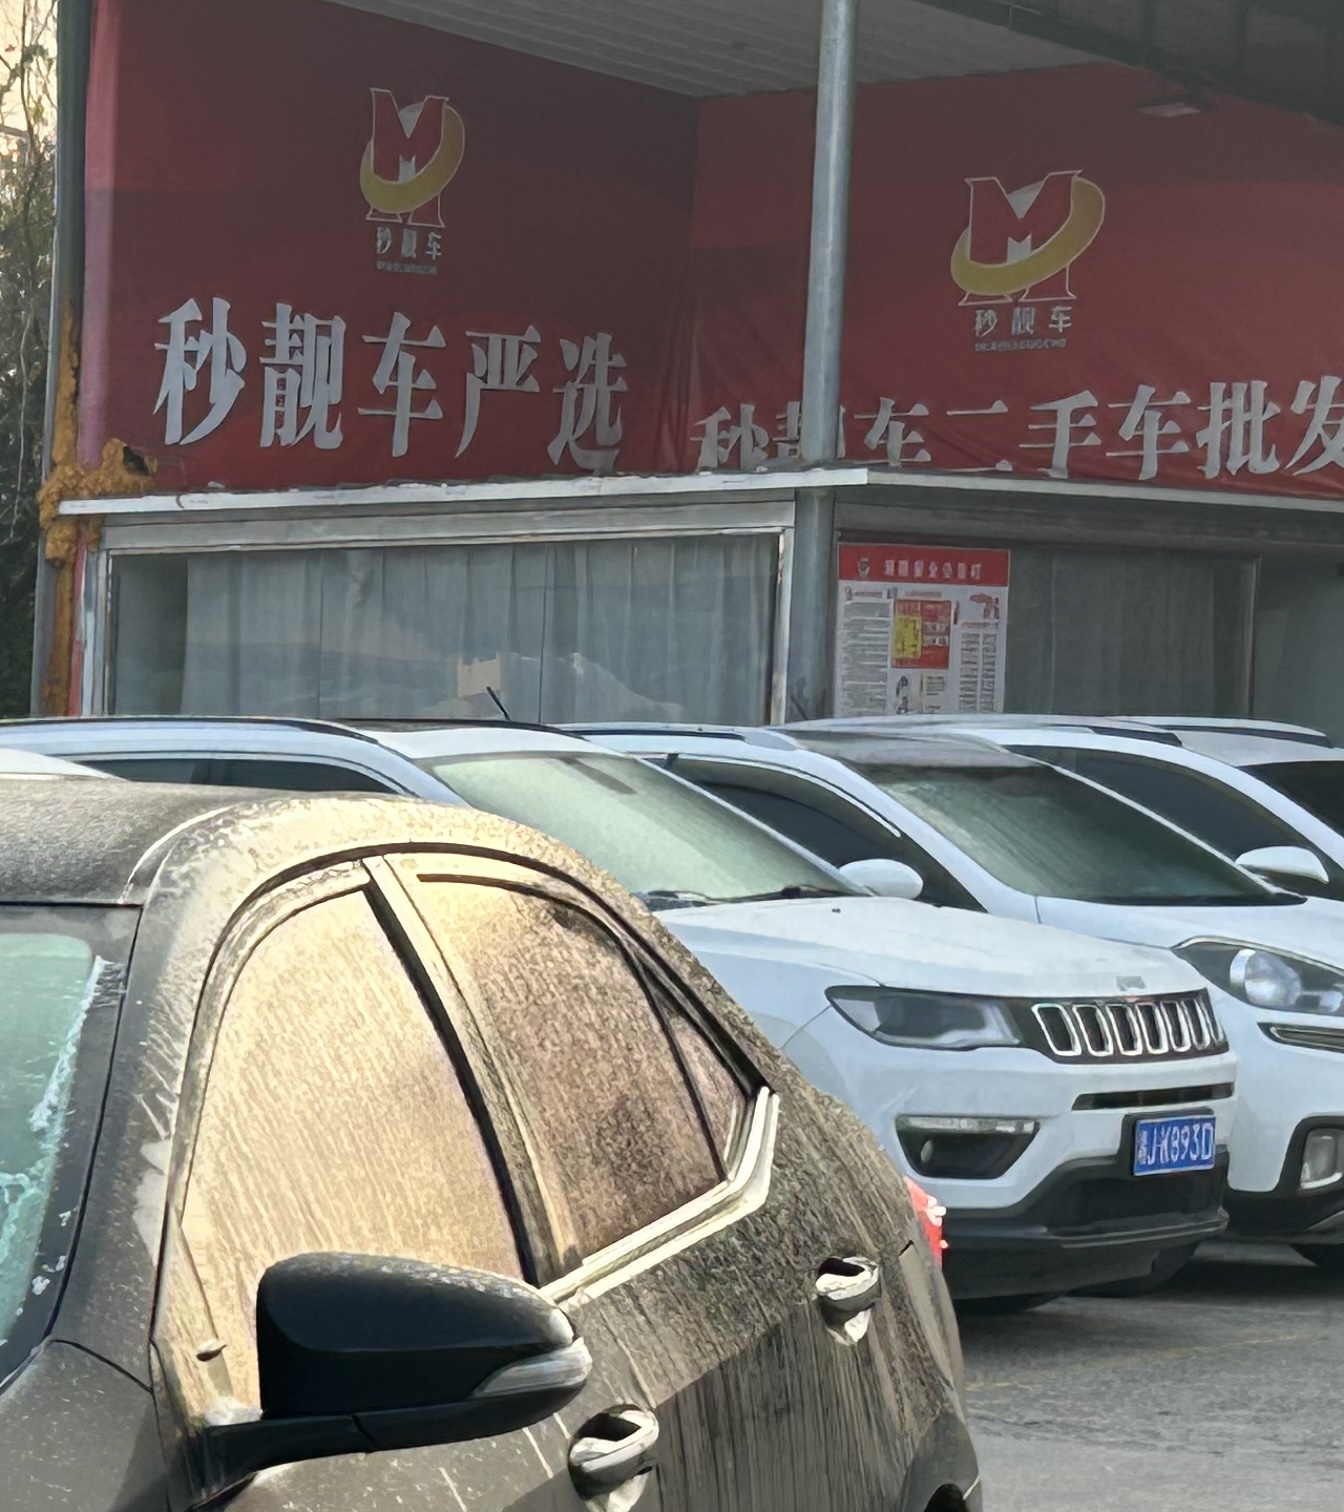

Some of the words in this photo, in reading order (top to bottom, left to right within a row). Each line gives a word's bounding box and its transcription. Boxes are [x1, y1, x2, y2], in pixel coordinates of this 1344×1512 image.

[152, 297, 629, 475] 秒靓车严选
